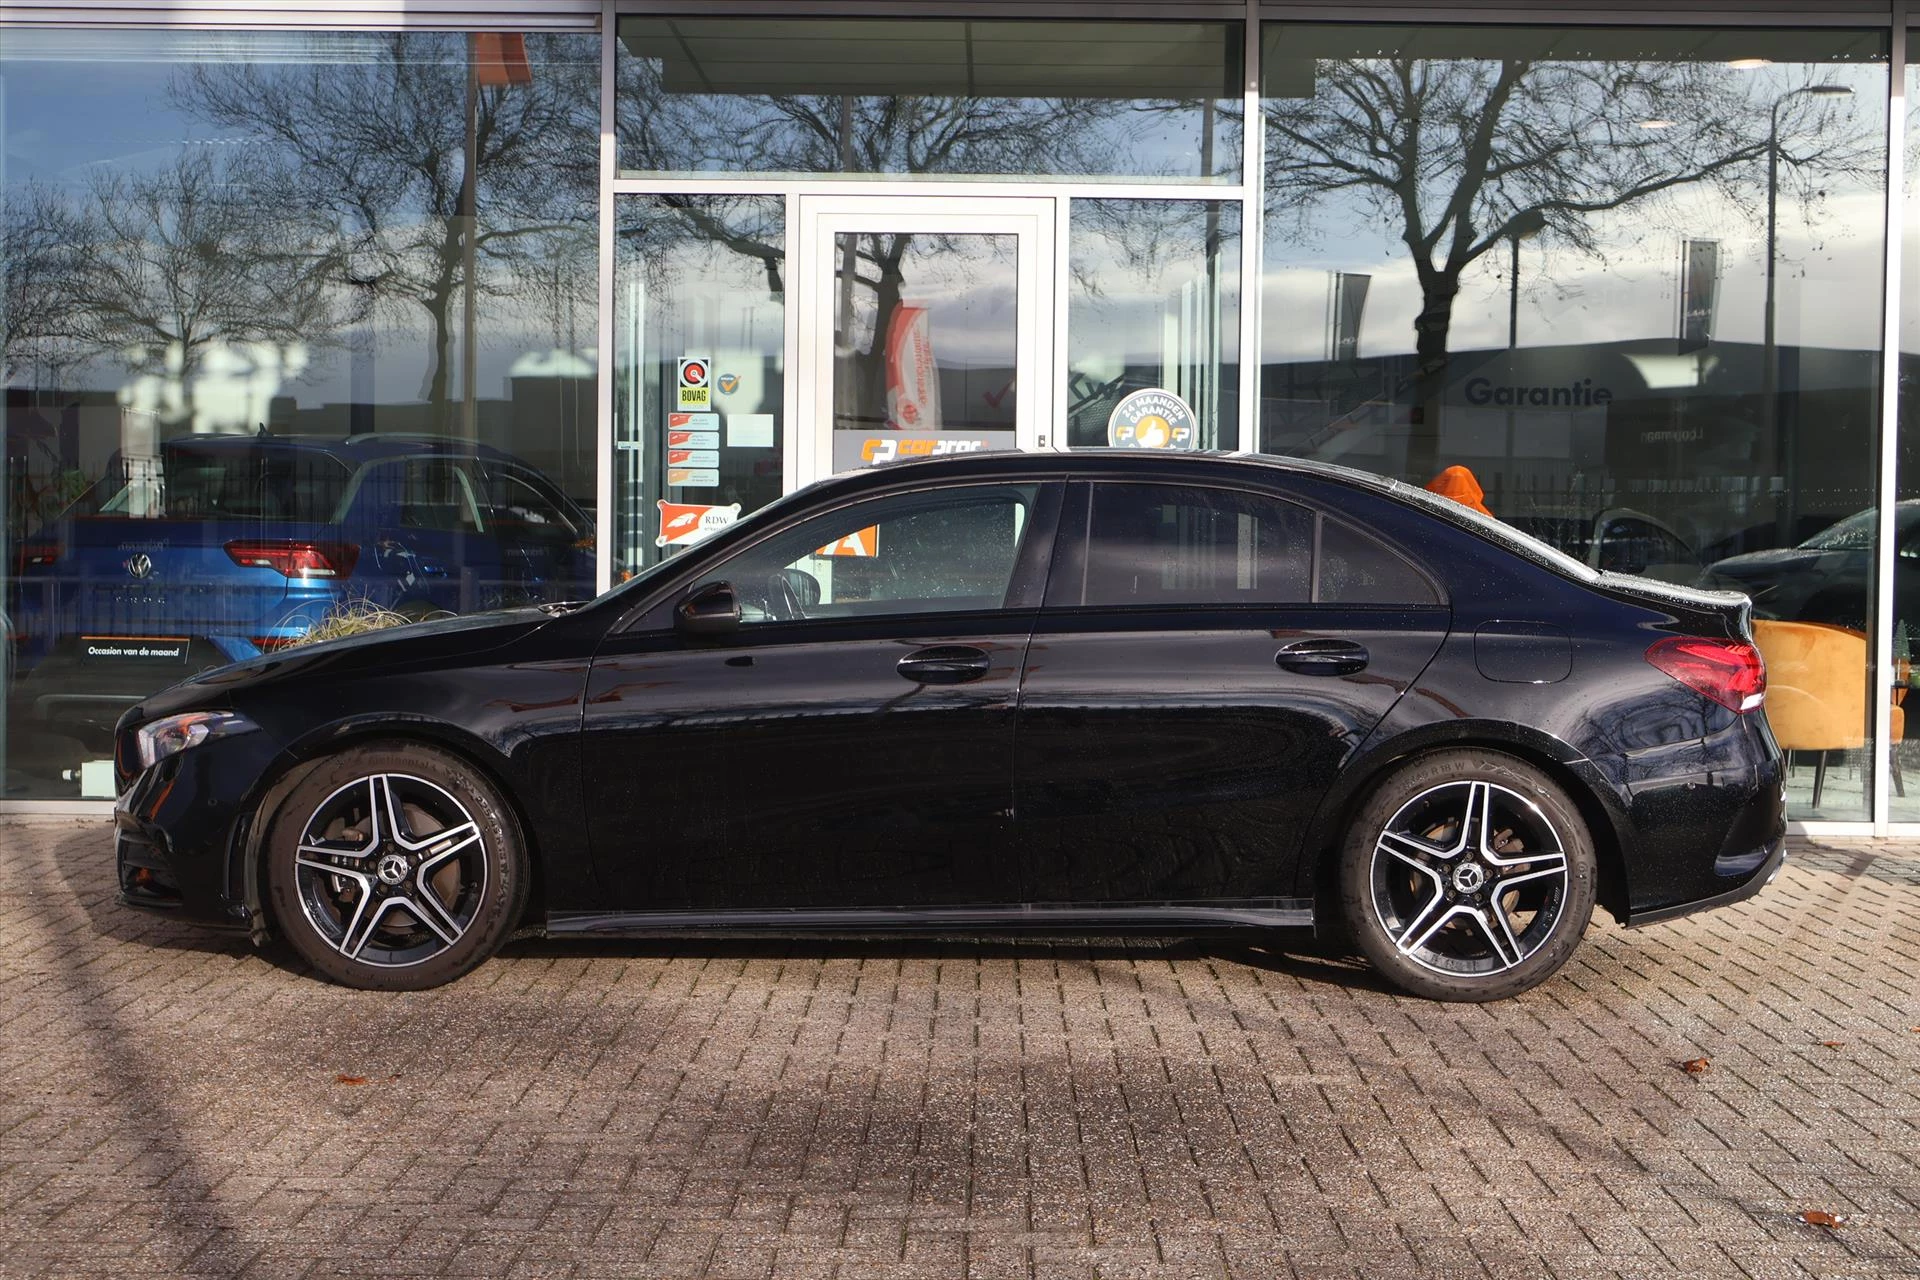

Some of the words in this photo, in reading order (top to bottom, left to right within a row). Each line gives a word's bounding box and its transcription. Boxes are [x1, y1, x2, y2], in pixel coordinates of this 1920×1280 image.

[682, 389, 706, 402] BOVAG
[1464, 377, 1613, 406] Garantie
[1122, 405, 1136, 418] 24
[1136, 396, 1186, 420] MAANDEN
[1130, 406, 1178, 426] GARANTIE
[705, 515, 729, 524] RDW
[88, 646, 121, 656] Occasion
[123, 648, 137, 656] van
[139, 646, 149, 656] de
[150, 647, 180, 657] maand
